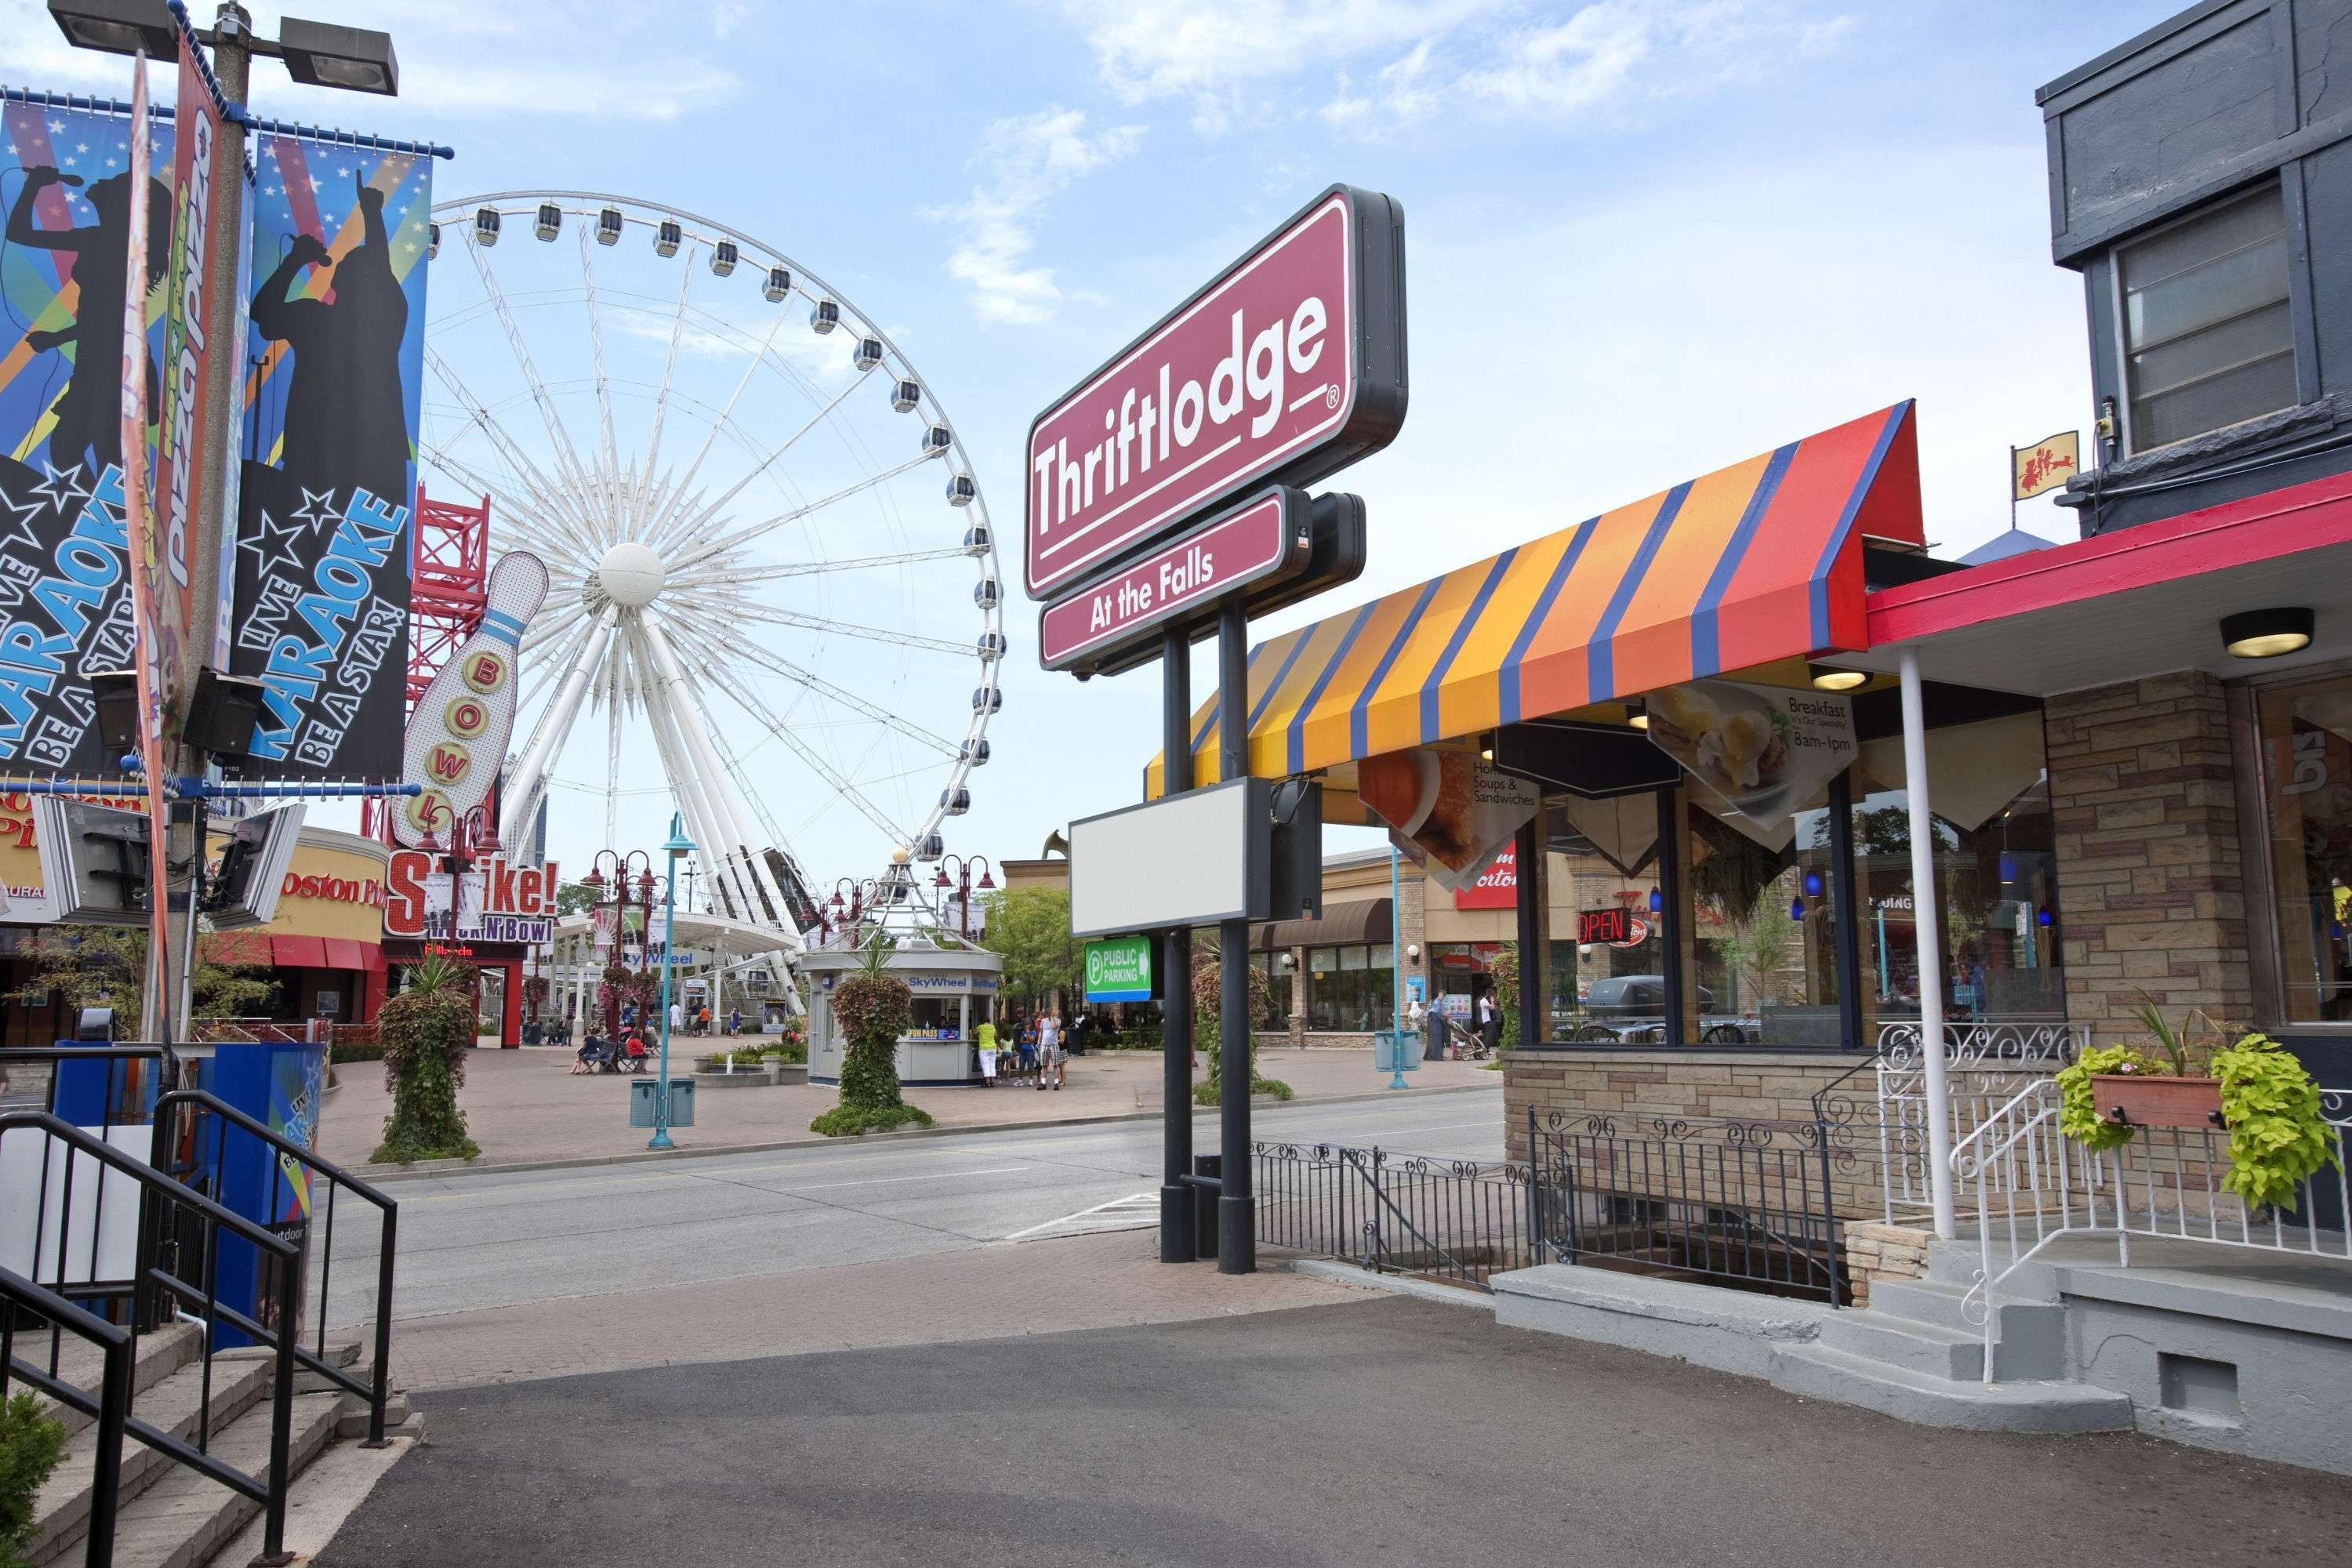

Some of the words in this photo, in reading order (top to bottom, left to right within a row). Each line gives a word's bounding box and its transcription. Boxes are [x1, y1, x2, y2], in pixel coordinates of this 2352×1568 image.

[1034, 296, 1327, 536] Thriftlodge
[1091, 598, 1111, 633] At
[1118, 580, 1151, 619] the
[1160, 546, 1213, 601] Falls
[238, 575, 301, 651] LIVE
[249, 486, 410, 760] KARAOKE
[337, 596, 406, 692] STAR!
[25, 716, 84, 768] BE
[59, 686, 96, 727] A
[78, 583, 139, 681] STAR
[332, 691, 361, 731] A
[1788, 696, 1846, 717] Breakfast
[295, 719, 340, 768] BE
[418, 656, 499, 823] BOWL
[1474, 775, 1505, 792] Soups
[1508, 778, 1518, 790] &
[1474, 790, 1535, 806] Sandwiches
[281, 872, 360, 902] oston
[385, 850, 559, 936] Sike!
[1577, 910, 1624, 943] OPEN
[1103, 948, 1137, 967] PUBLIC
[909, 976, 967, 988] SkyWheel
[1103, 967, 1138, 983] PARKING
[909, 1029, 921, 1038] FUN
[922, 1029, 938, 1038] PASS
[292, 1088, 312, 1112] LIVE
[276, 1228, 303, 1242] utdoor
